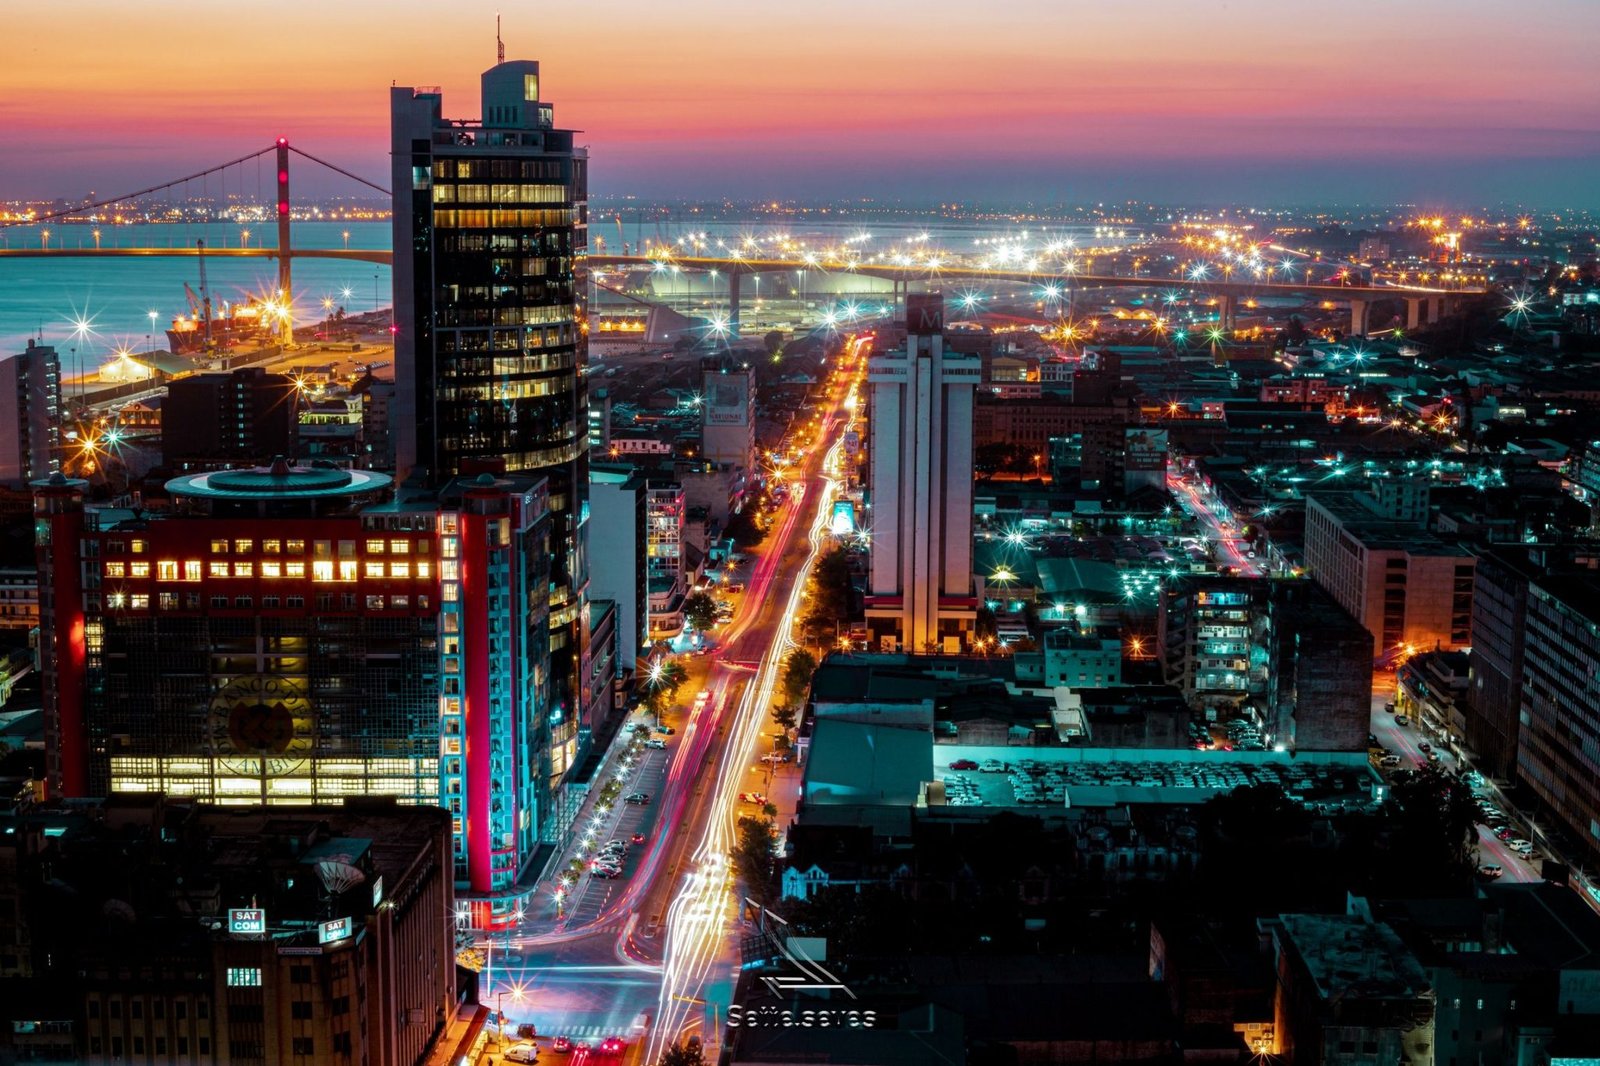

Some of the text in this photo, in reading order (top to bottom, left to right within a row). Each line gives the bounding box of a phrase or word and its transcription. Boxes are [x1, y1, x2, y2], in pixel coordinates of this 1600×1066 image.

[920, 308, 942, 329] M
[214, 678, 278, 718] BANCO
[236, 911, 258, 920] SAT
[234, 921, 260, 930] COM
[327, 921, 343, 931] SAT
[326, 928, 345, 940] COM
